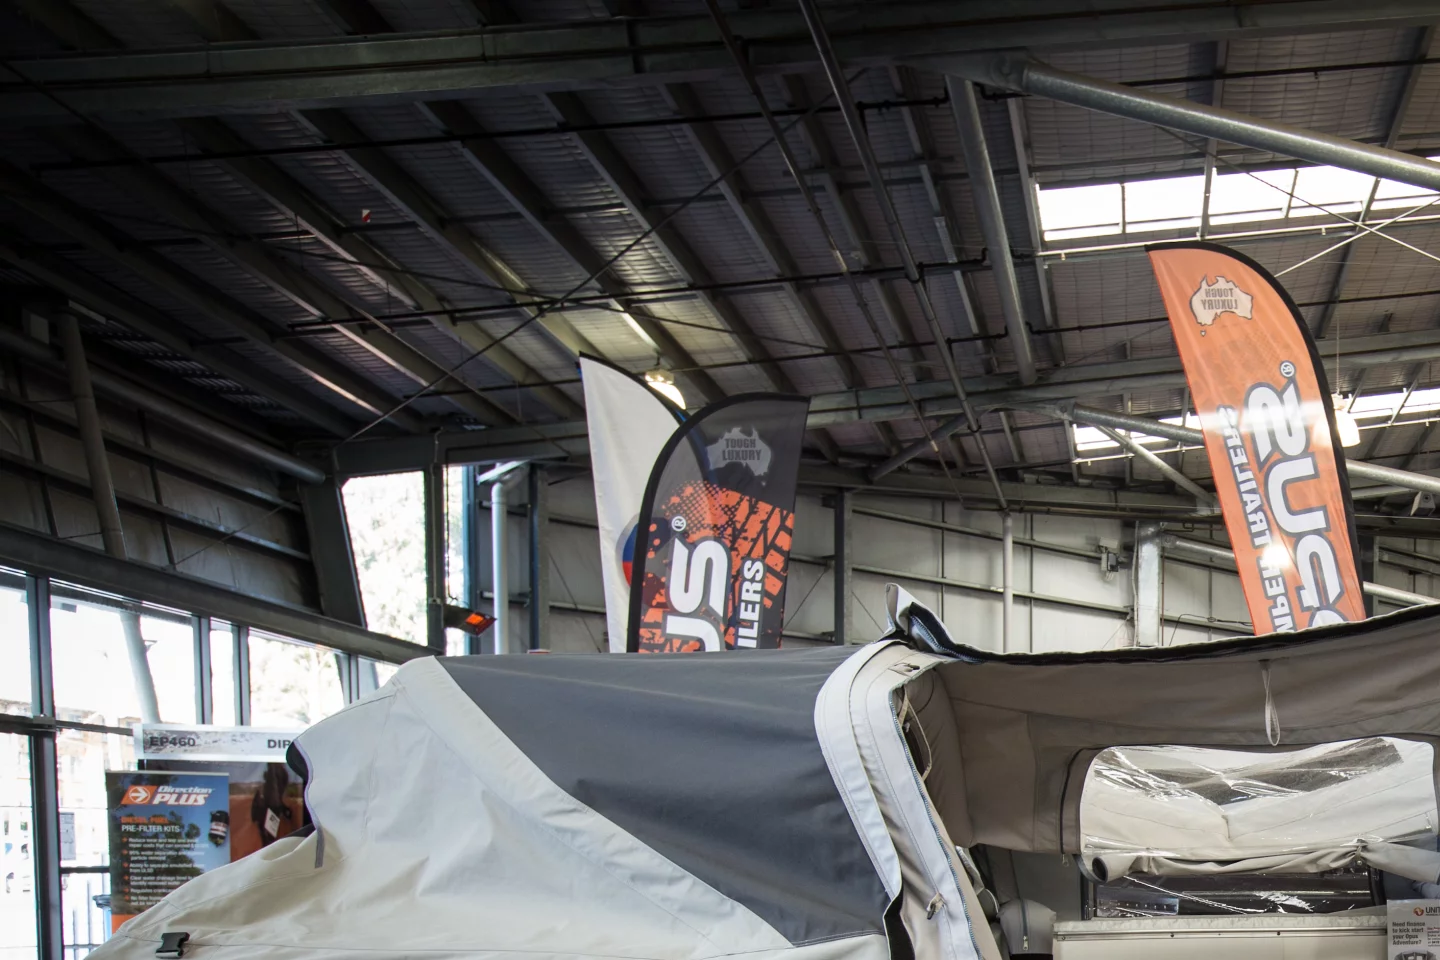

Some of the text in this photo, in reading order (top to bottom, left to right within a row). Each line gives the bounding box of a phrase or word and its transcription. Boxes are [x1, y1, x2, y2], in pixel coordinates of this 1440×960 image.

[725, 438, 757, 449] TOUGH
[722, 449, 762, 461] LUXURY
[150, 736, 196, 747] EP460
[158, 785, 212, 794] Direction
[152, 793, 209, 805] PLUS
[121, 824, 163, 832] PRE-FILTER
